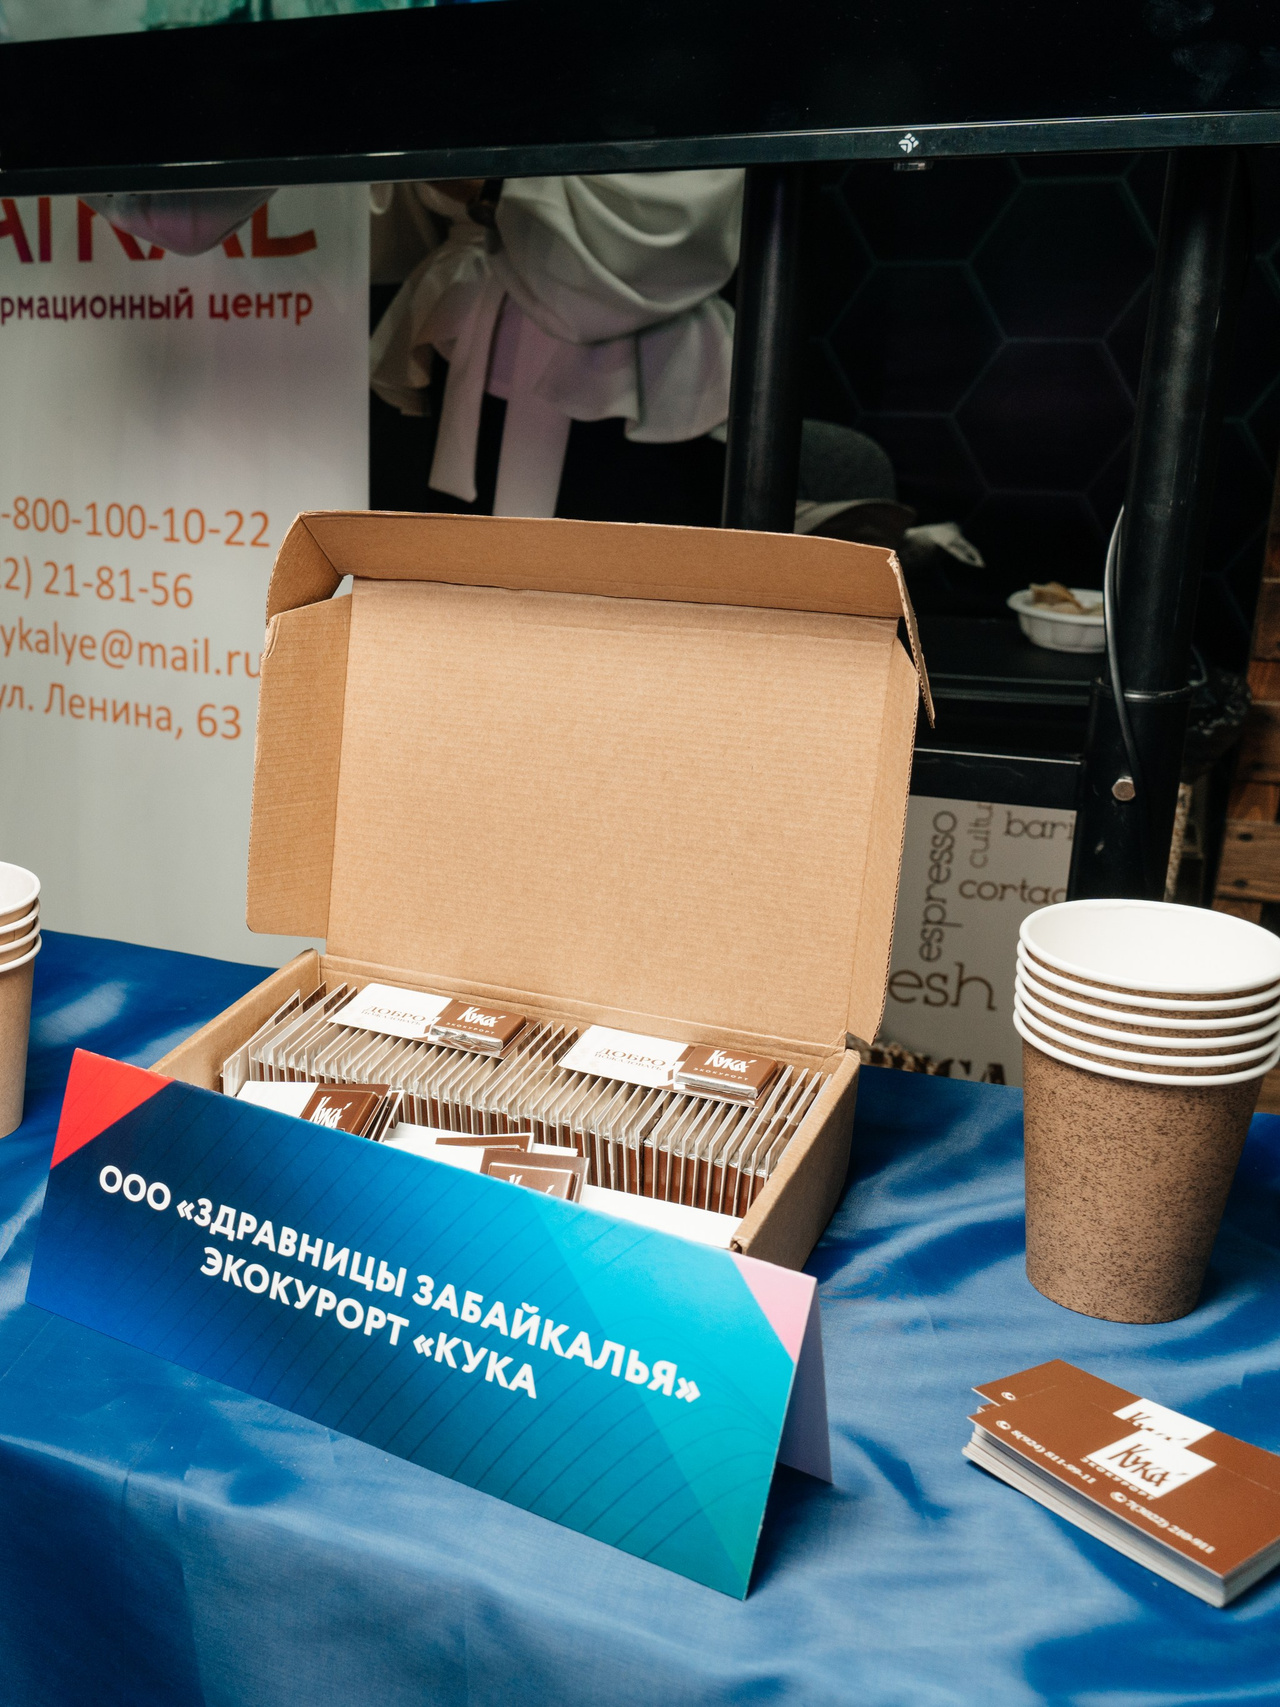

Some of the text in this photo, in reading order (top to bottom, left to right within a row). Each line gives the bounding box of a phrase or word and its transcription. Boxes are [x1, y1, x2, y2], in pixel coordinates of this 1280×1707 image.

[209, 291, 314, 325] центр
[44, 561, 194, 609] 21-81-56
[44, 682, 184, 740] Ленина,
[197, 703, 243, 740] 63
[920, 810, 962, 963] espresso
[889, 962, 997, 1011] esh
[597, 1047, 666, 1067] ДОБРО
[98, 1165, 701, 1403] ООО «ЗДРАВНИЦЫ ЗАБАЙКАЛЬЯ»
[199, 1246, 537, 1400] ЭКОКУРОРТ «КУКА
